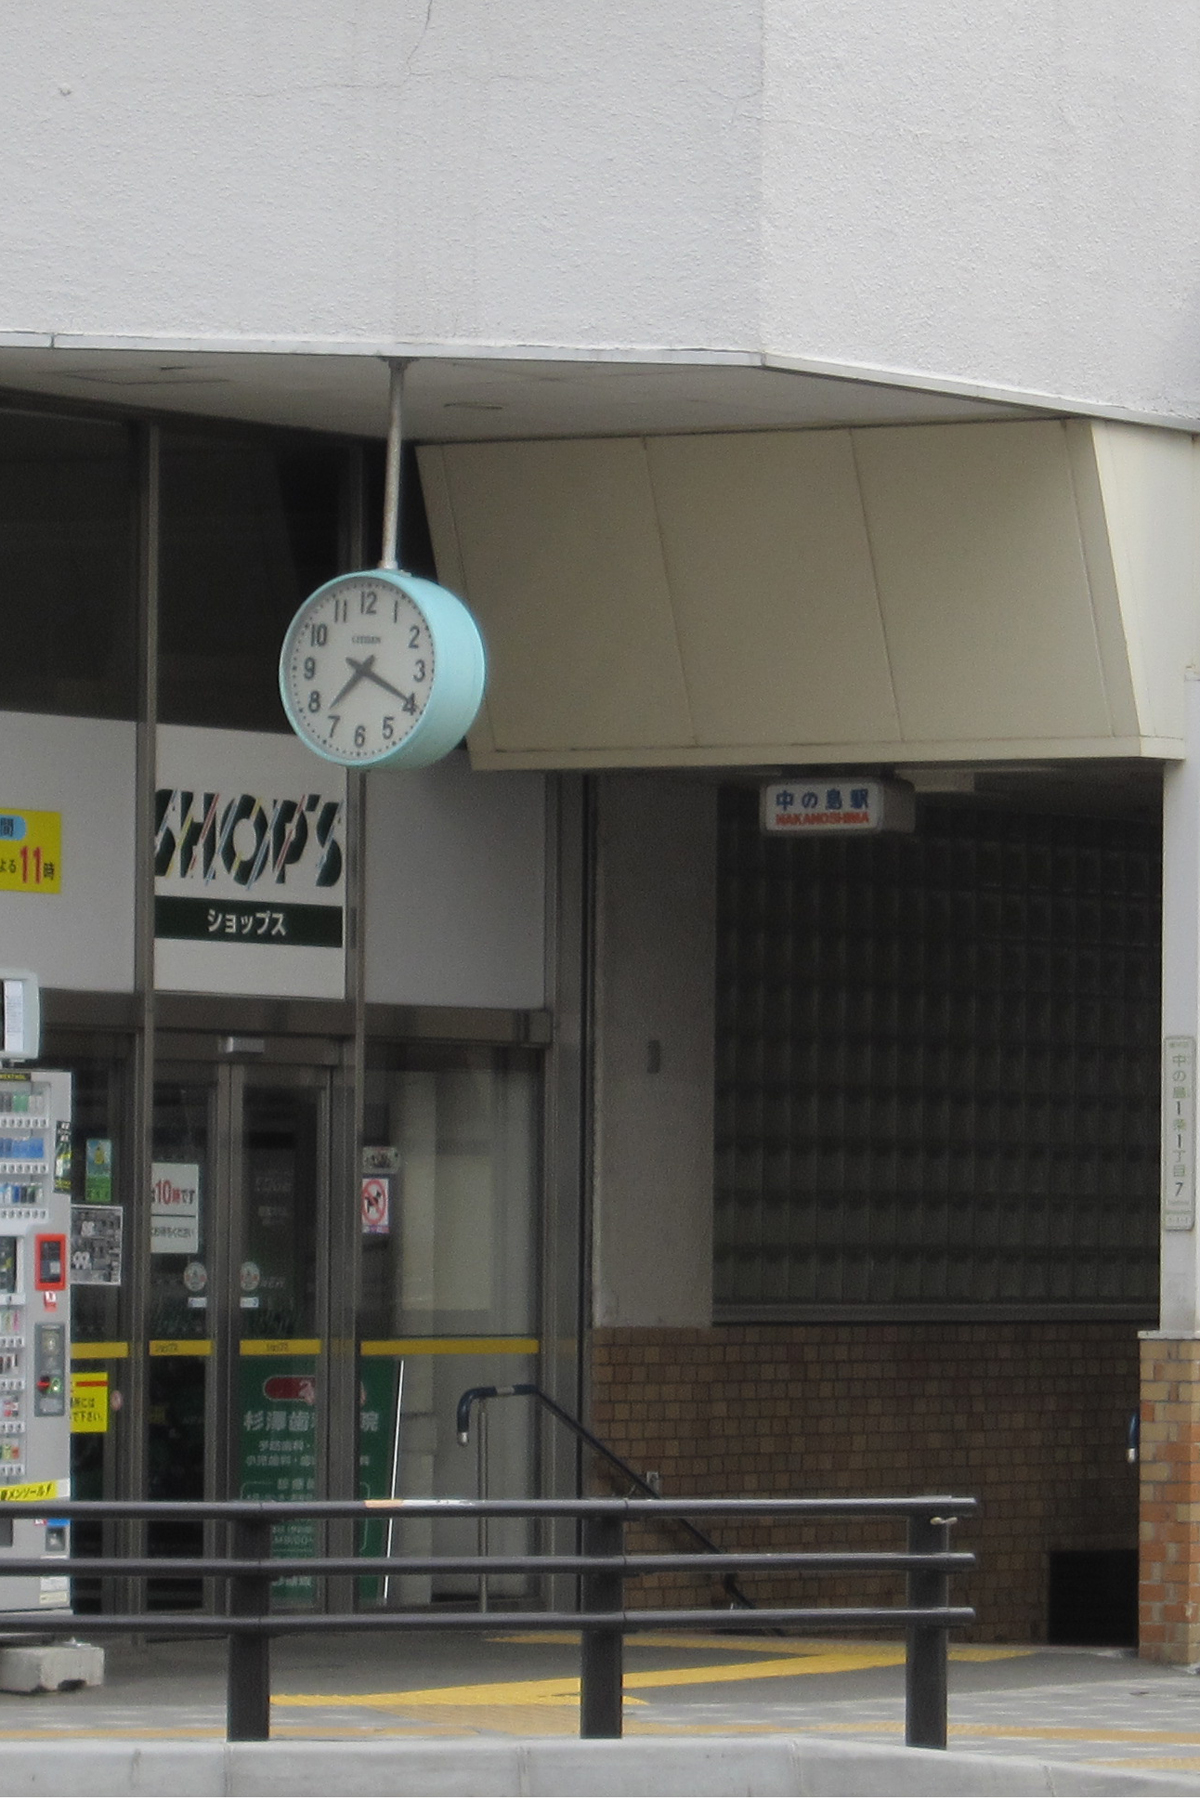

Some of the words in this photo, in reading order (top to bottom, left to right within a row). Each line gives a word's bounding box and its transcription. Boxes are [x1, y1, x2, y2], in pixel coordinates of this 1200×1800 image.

[334, 600, 347, 623] 11
[360, 591, 377, 615] 12
[393, 600, 399, 624] 1
[310, 623, 328, 647] 10
[408, 626, 421, 649] 2
[304, 657, 316, 680] 9
[413, 659, 426, 683] 3
[308, 690, 321, 713] 8
[402, 692, 417, 716] 4
[327, 715, 341, 738] 7
[353, 725, 366, 748] 6
[382, 716, 395, 739] 5
[775, 789, 869, 811] 中の島駅
[207, 908, 287, 937] ショップス
